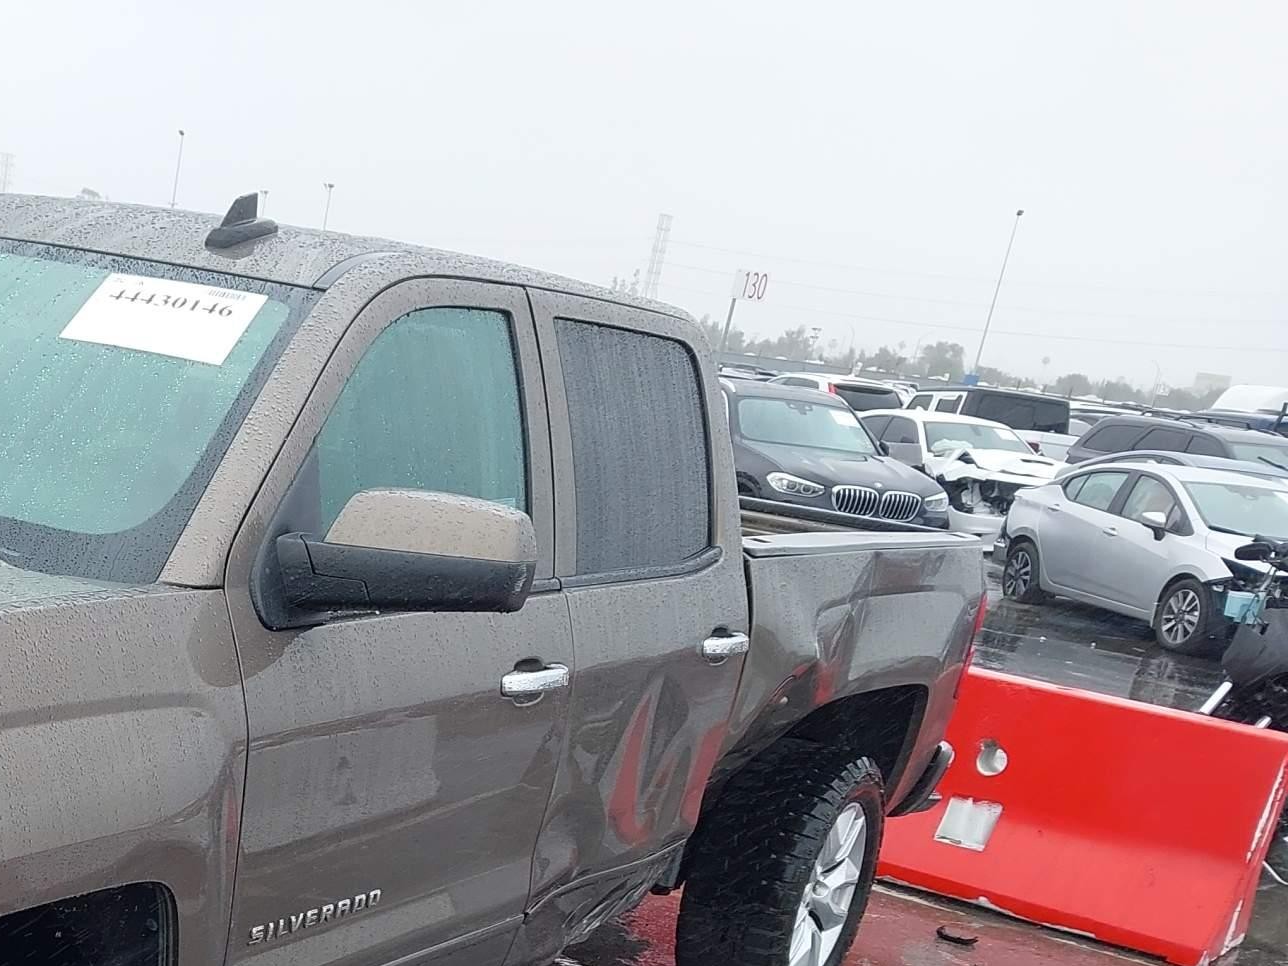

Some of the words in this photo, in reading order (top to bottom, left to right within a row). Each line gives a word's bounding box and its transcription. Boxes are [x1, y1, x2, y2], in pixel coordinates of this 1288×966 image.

[742, 271, 768, 300] 130
[109, 288, 233, 318] 44430146
[247, 888, 382, 945] SILVERADO
